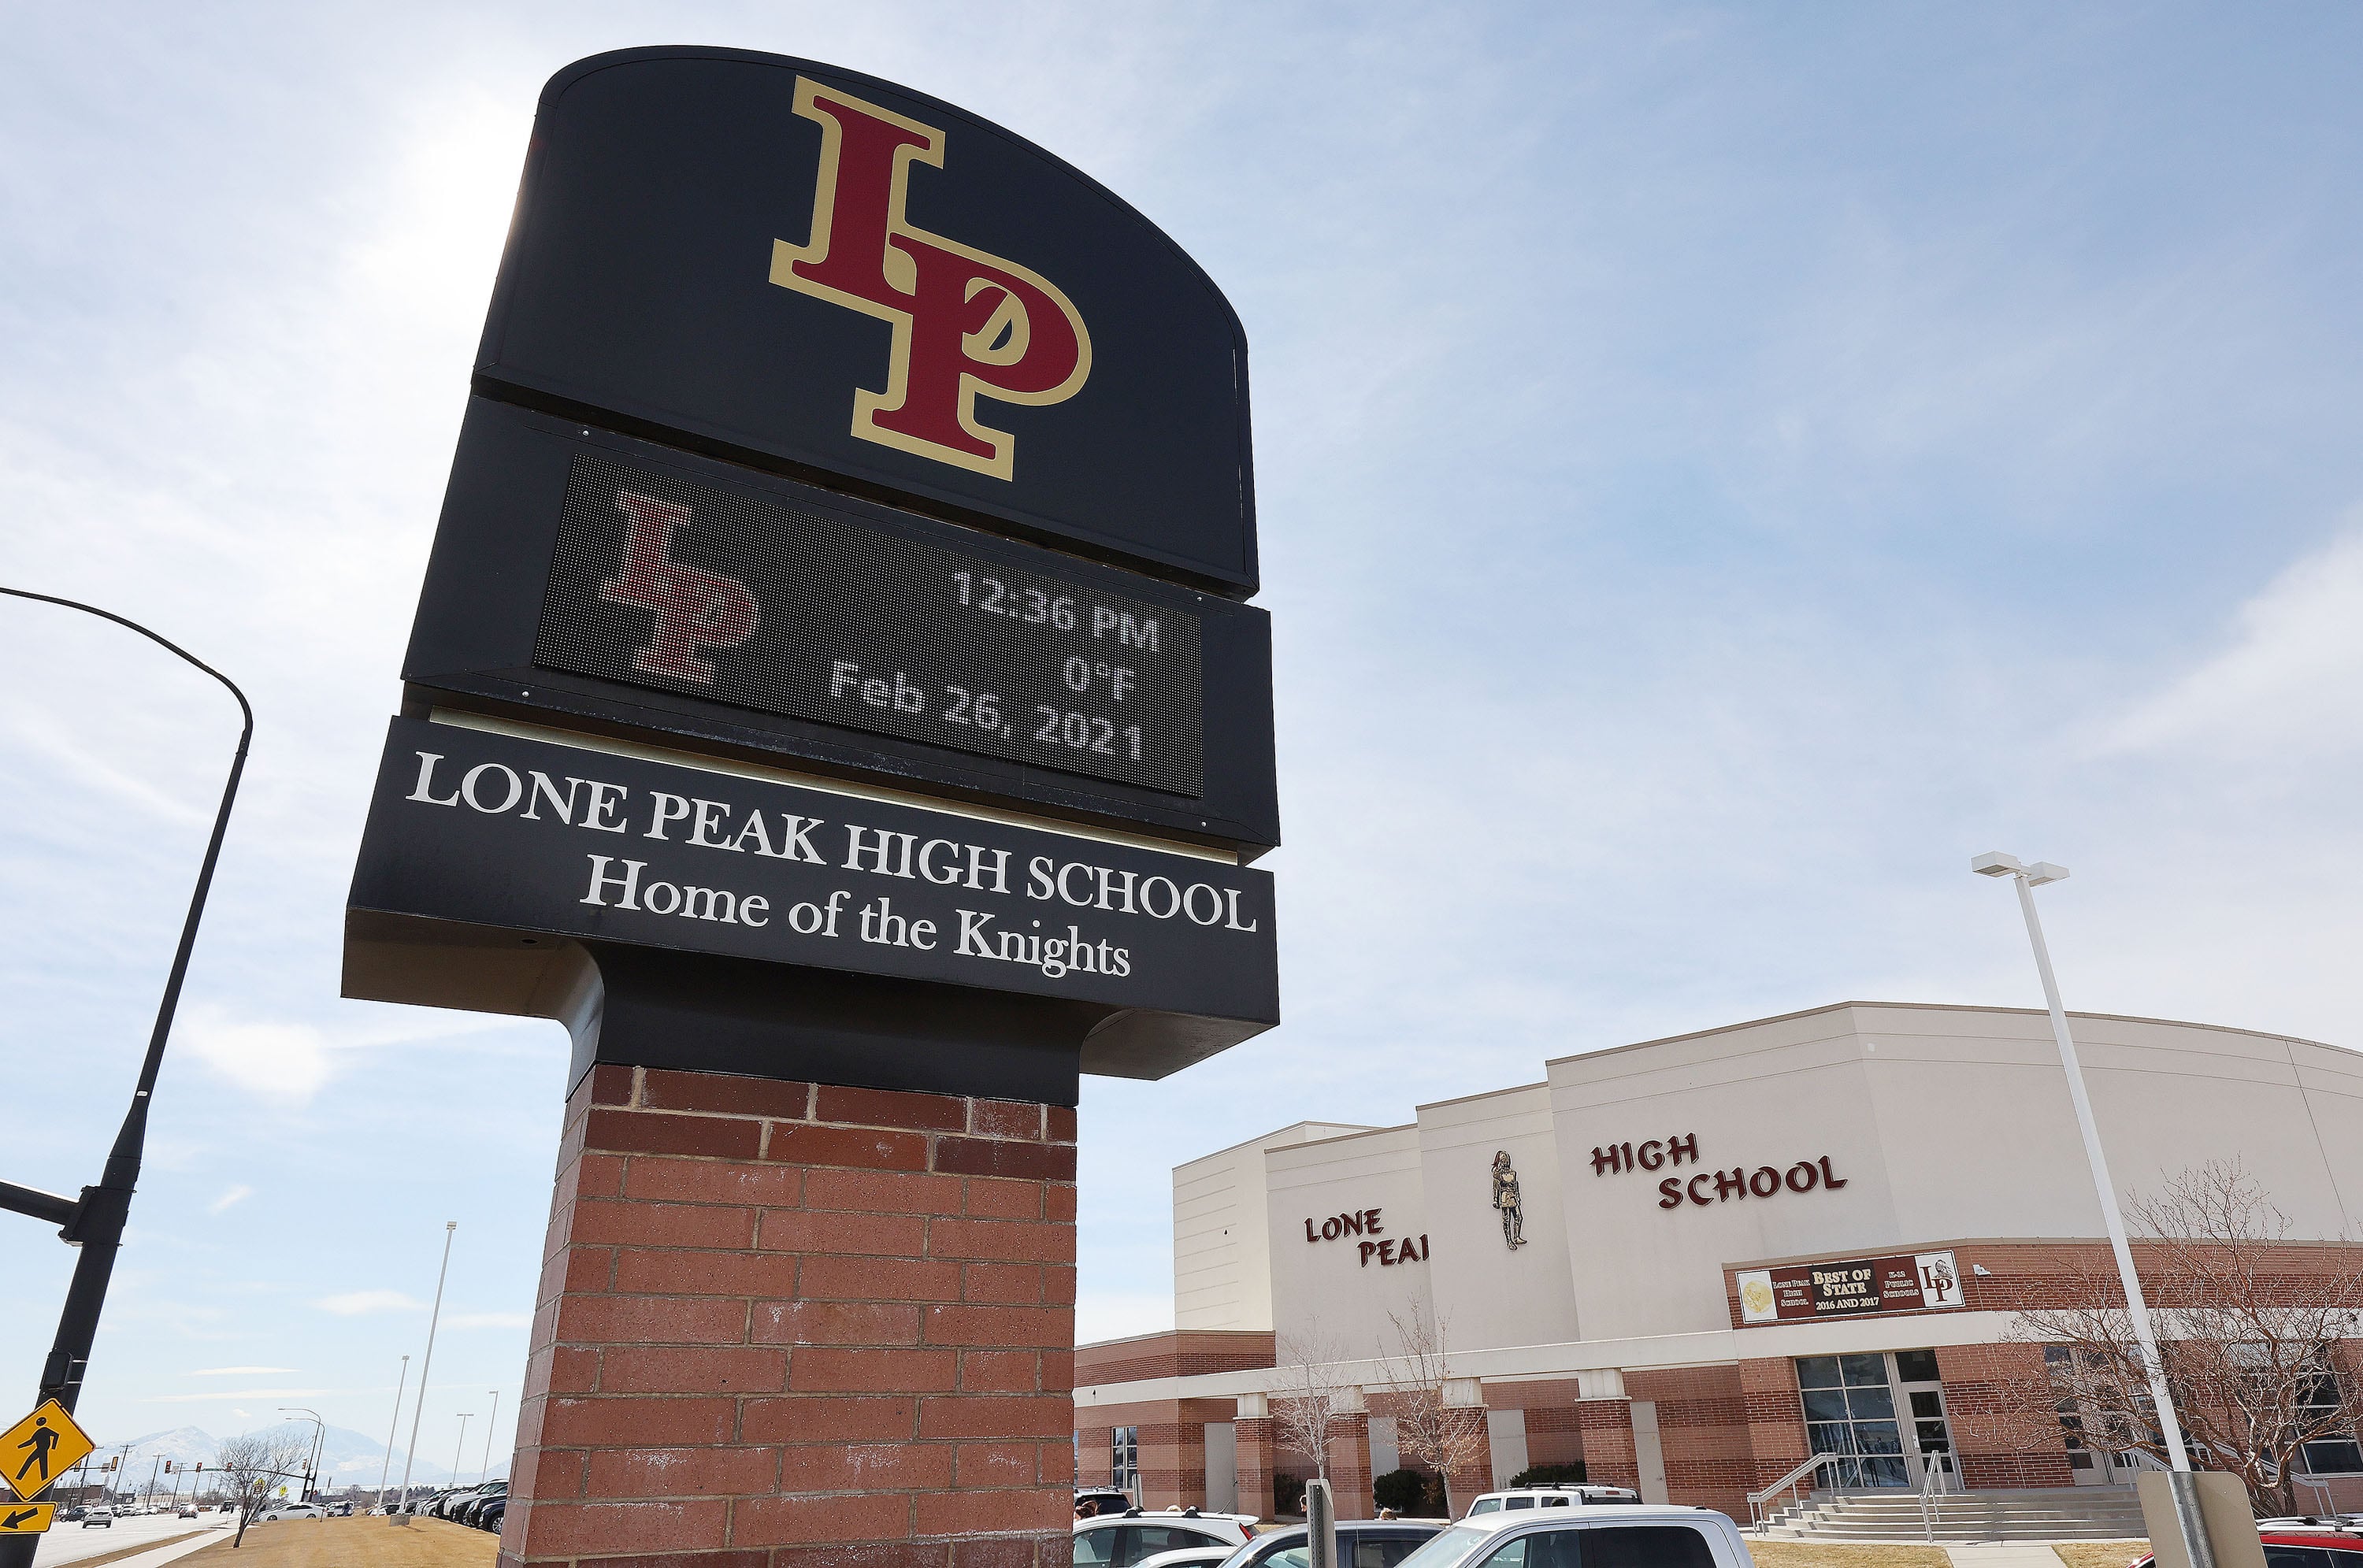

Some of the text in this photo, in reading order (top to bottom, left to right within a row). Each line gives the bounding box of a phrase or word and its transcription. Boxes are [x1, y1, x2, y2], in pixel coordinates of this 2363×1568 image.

[953, 570, 1159, 652] 12:36 PM
[830, 660, 1141, 760] Feb 26, 2021
[405, 751, 1257, 933] LONE PEAK HIGH SCHOOL
[579, 854, 1131, 979] Home of the Knights
[1590, 1132, 1698, 1177] HIGH
[1657, 1155, 1848, 1210] SCHOOL
[1304, 1208, 1384, 1242] LONE
[1812, 1269, 1871, 1284] BEST OF
[1823, 1282, 1866, 1296] STATE
[1816, 1296, 1879, 1310] 2016 AND 2017
